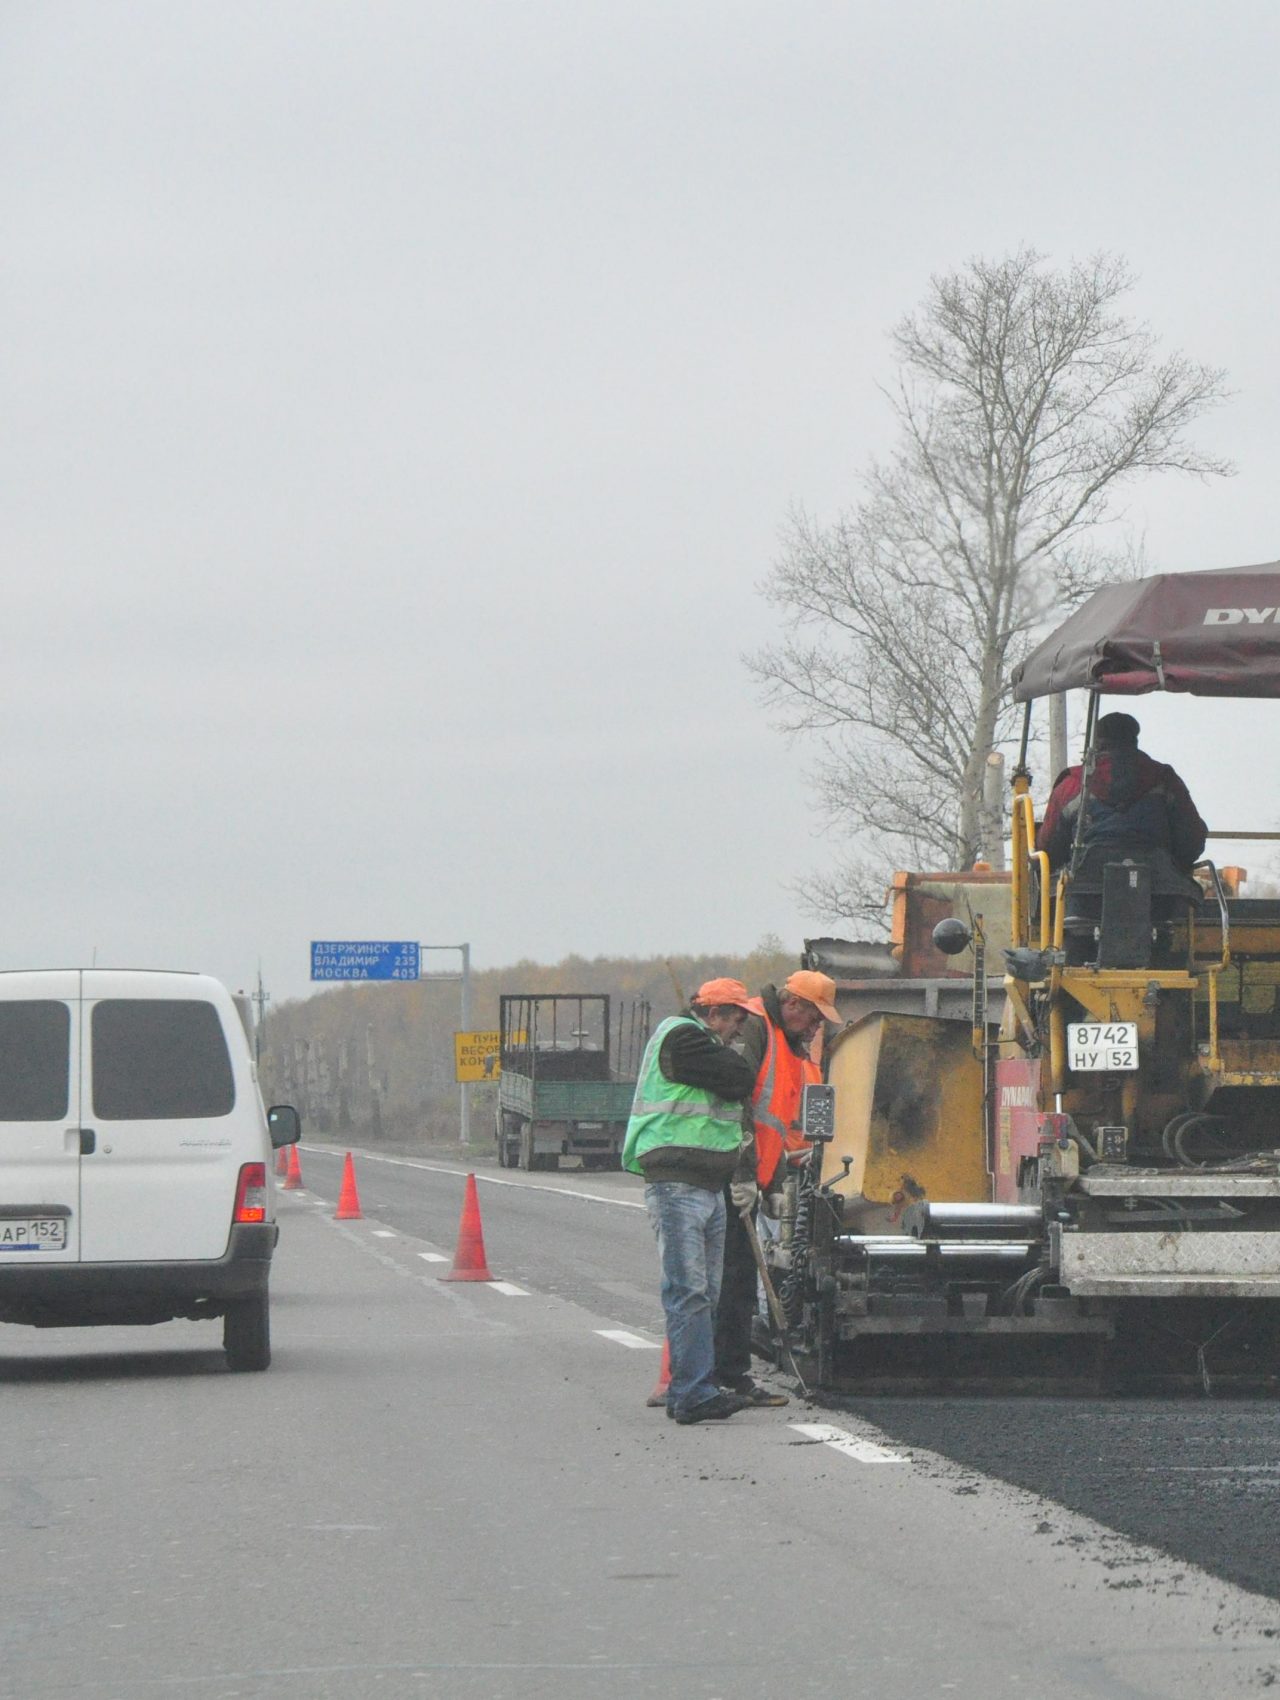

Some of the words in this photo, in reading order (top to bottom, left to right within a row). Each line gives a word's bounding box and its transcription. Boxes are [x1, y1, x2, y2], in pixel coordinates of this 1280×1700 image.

[315, 943, 390, 954] ДЗЕРЖИНСК
[401, 943, 416, 954] 25
[314, 956, 379, 967] ВЛАДИМИР
[394, 956, 416, 967] 235
[314, 968, 368, 978] МОСКВА
[392, 968, 416, 978] 405
[473, 1034, 499, 1044] ПУН
[1077, 1026, 1129, 1045] 8742
[1075, 1052, 1098, 1067] НУ
[1112, 1051, 1133, 1067] 52
[0, 1227, 26, 1242] АР
[31, 1221, 59, 1237] 152
